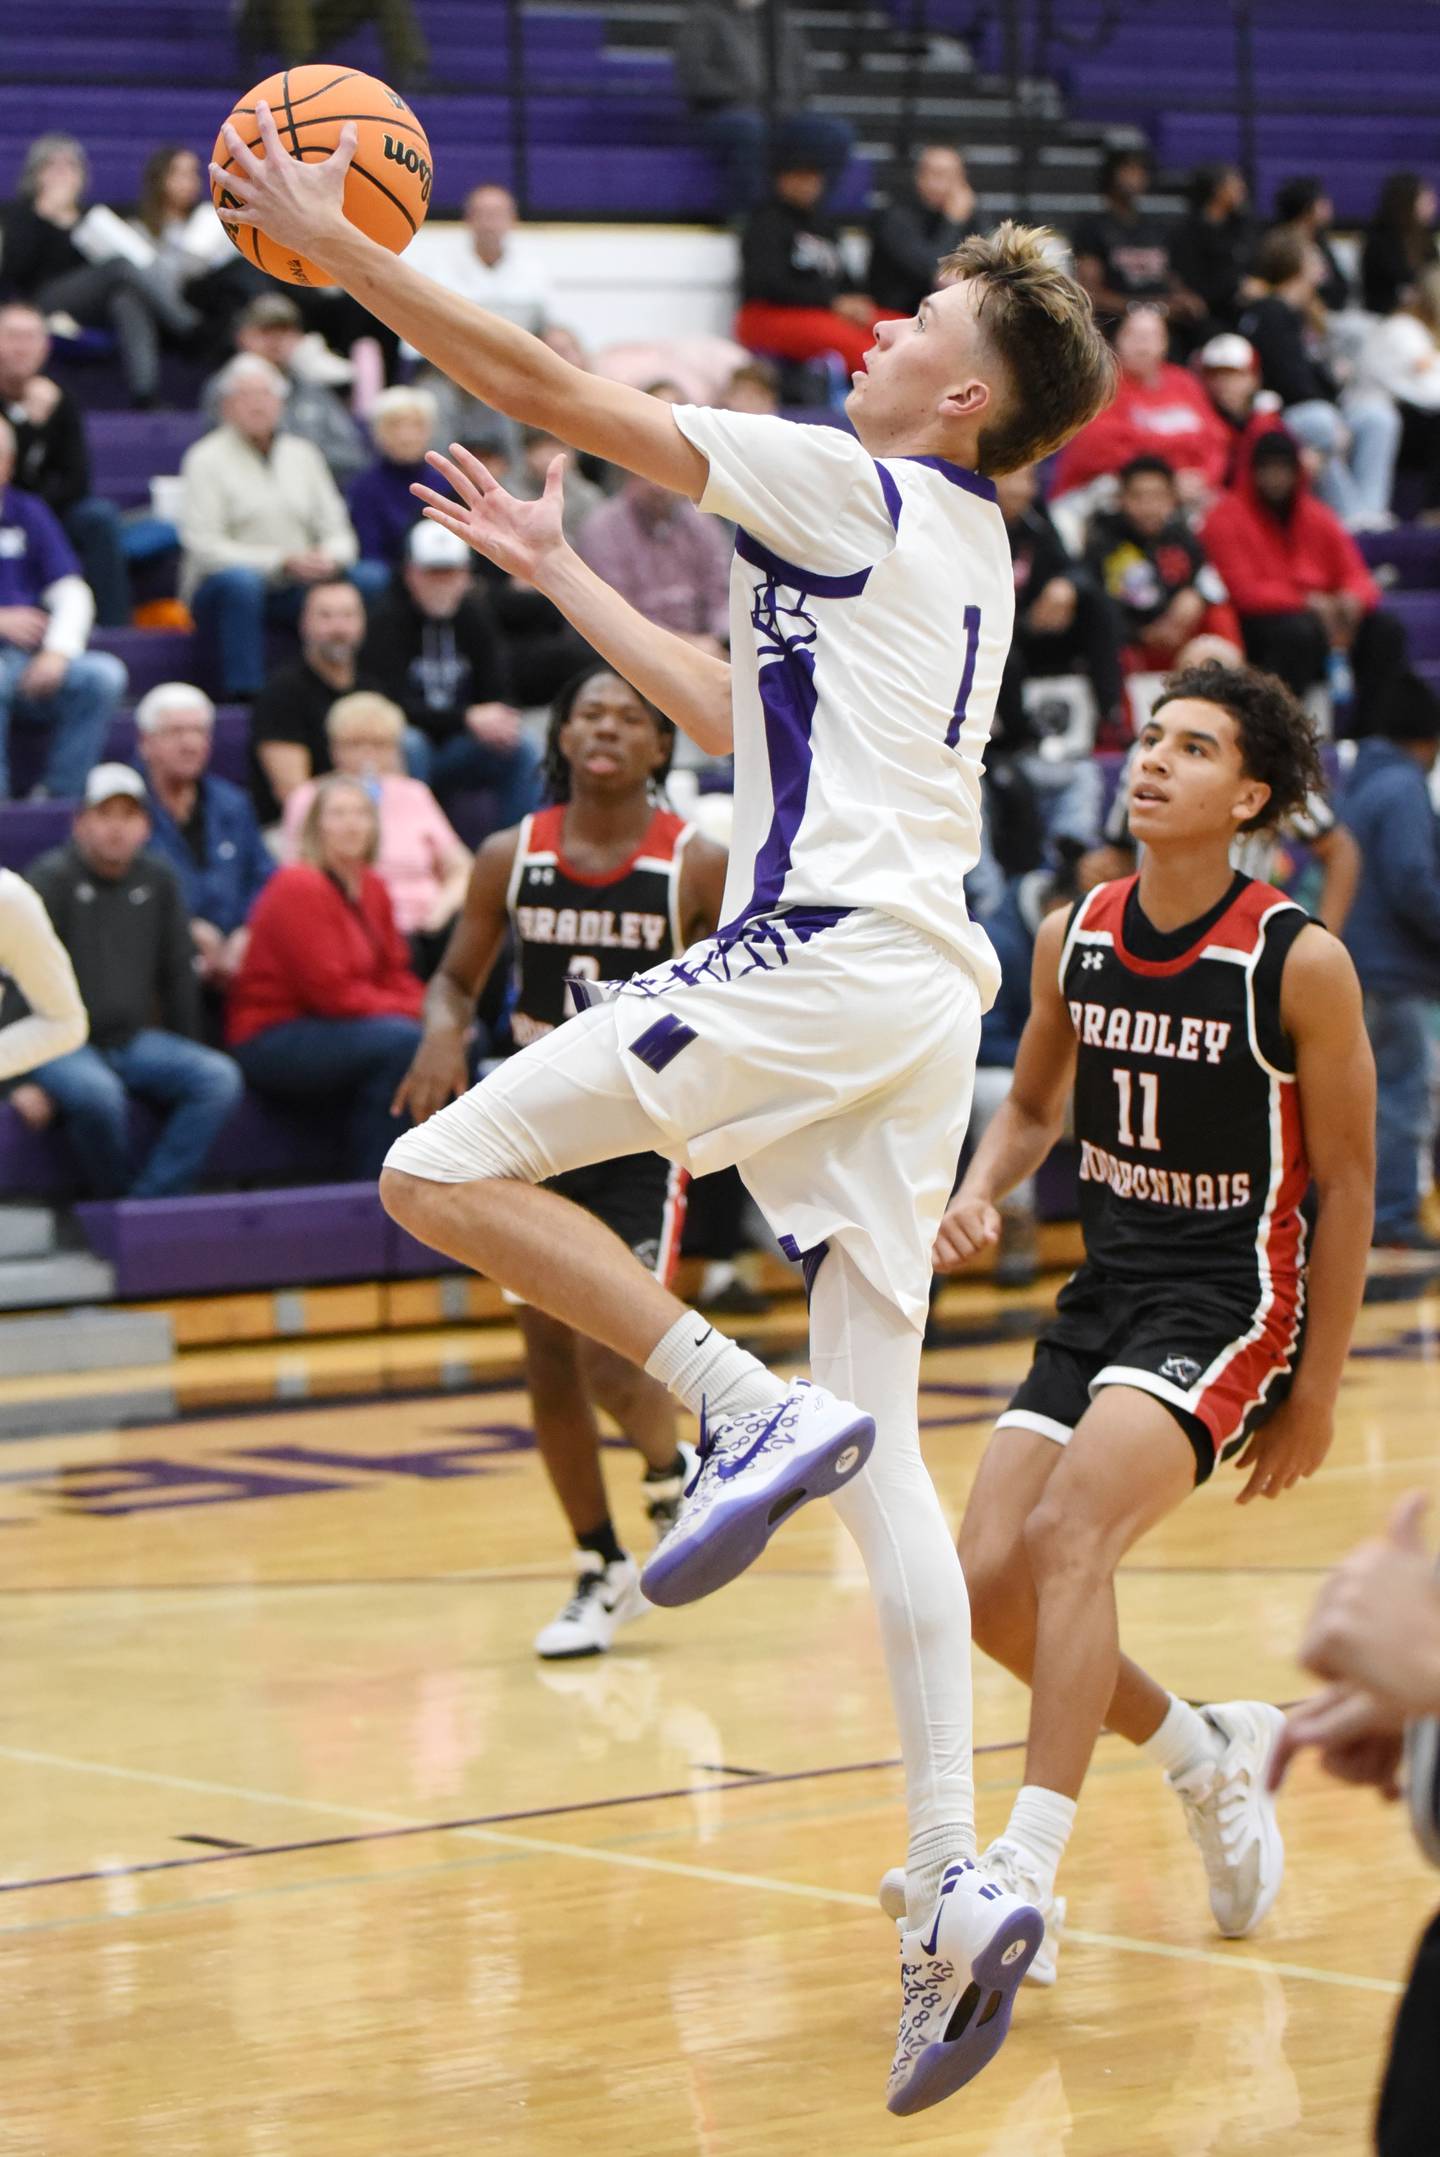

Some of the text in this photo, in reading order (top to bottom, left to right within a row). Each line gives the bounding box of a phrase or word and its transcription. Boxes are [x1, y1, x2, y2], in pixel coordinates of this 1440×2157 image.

[383, 134, 432, 202] lson
[944, 605, 981, 754] 1
[517, 906, 667, 950] BRADLEY
[1068, 1000, 1231, 1064] BRADLEY
[1112, 1067, 1161, 1151] 11
[1079, 1139, 1250, 1211] OBONNAIS
